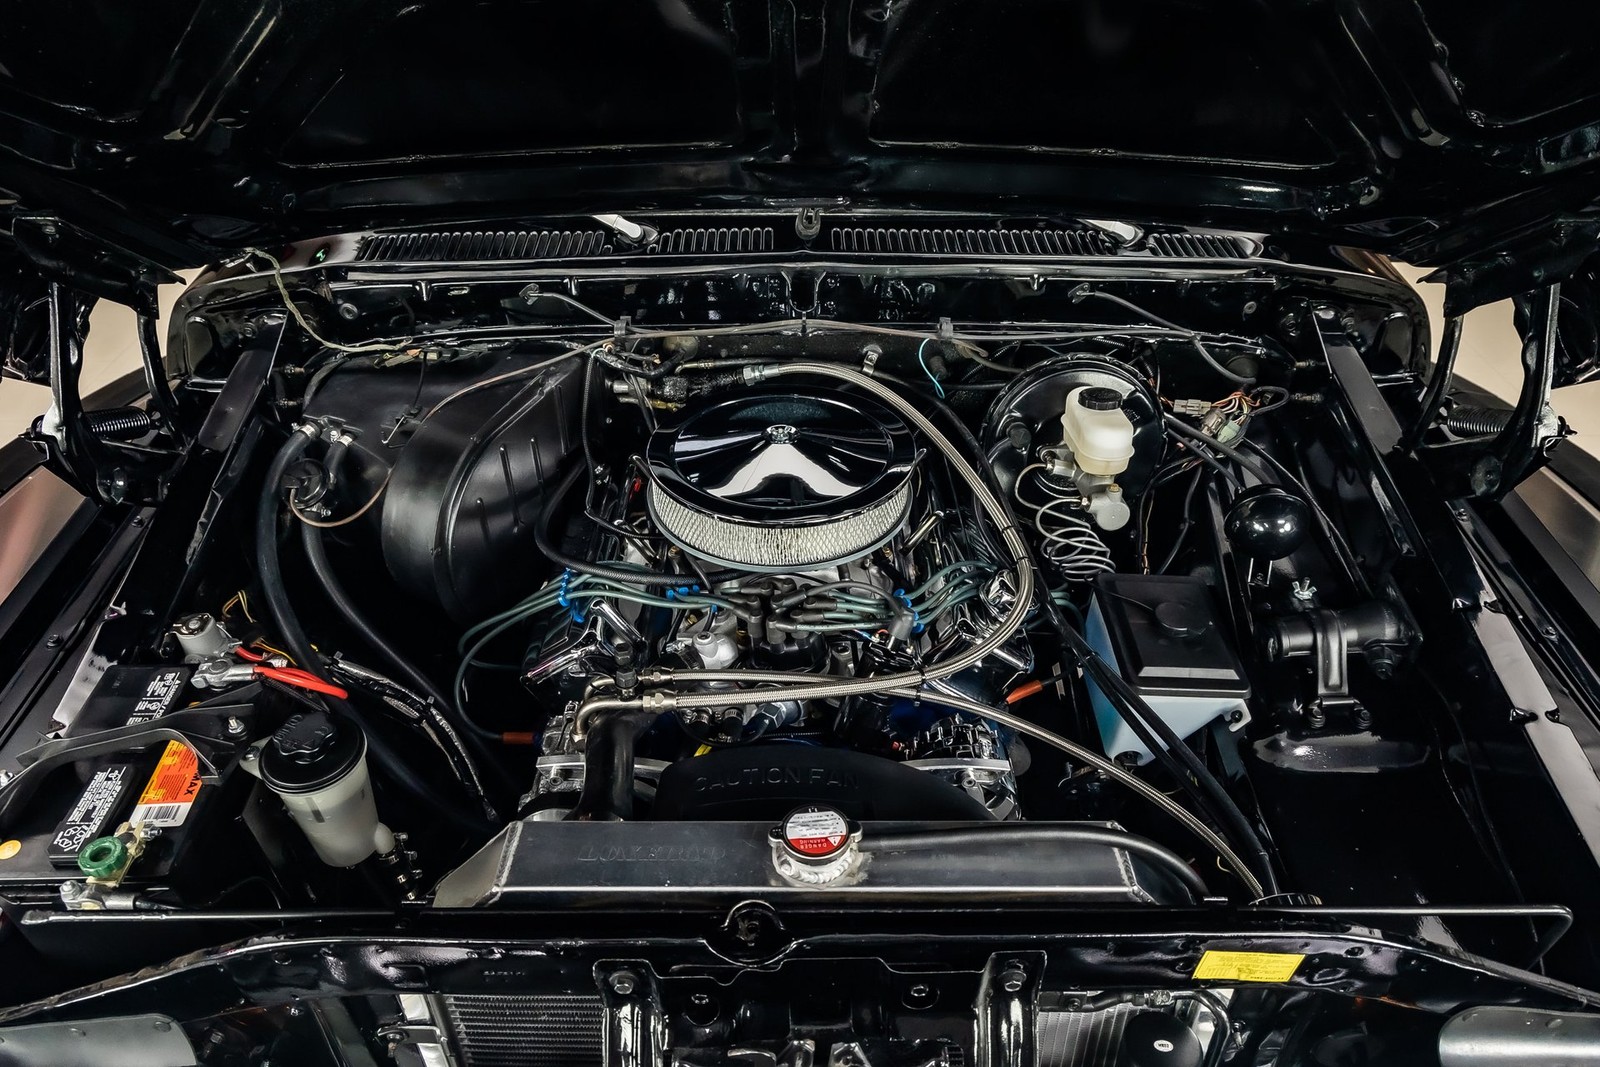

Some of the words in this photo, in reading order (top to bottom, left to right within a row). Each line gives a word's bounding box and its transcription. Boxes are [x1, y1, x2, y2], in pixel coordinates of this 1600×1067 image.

[695, 767, 801, 792] CAUTION
[809, 768, 860, 790] FAN
[799, 842, 827, 850] DANGER
